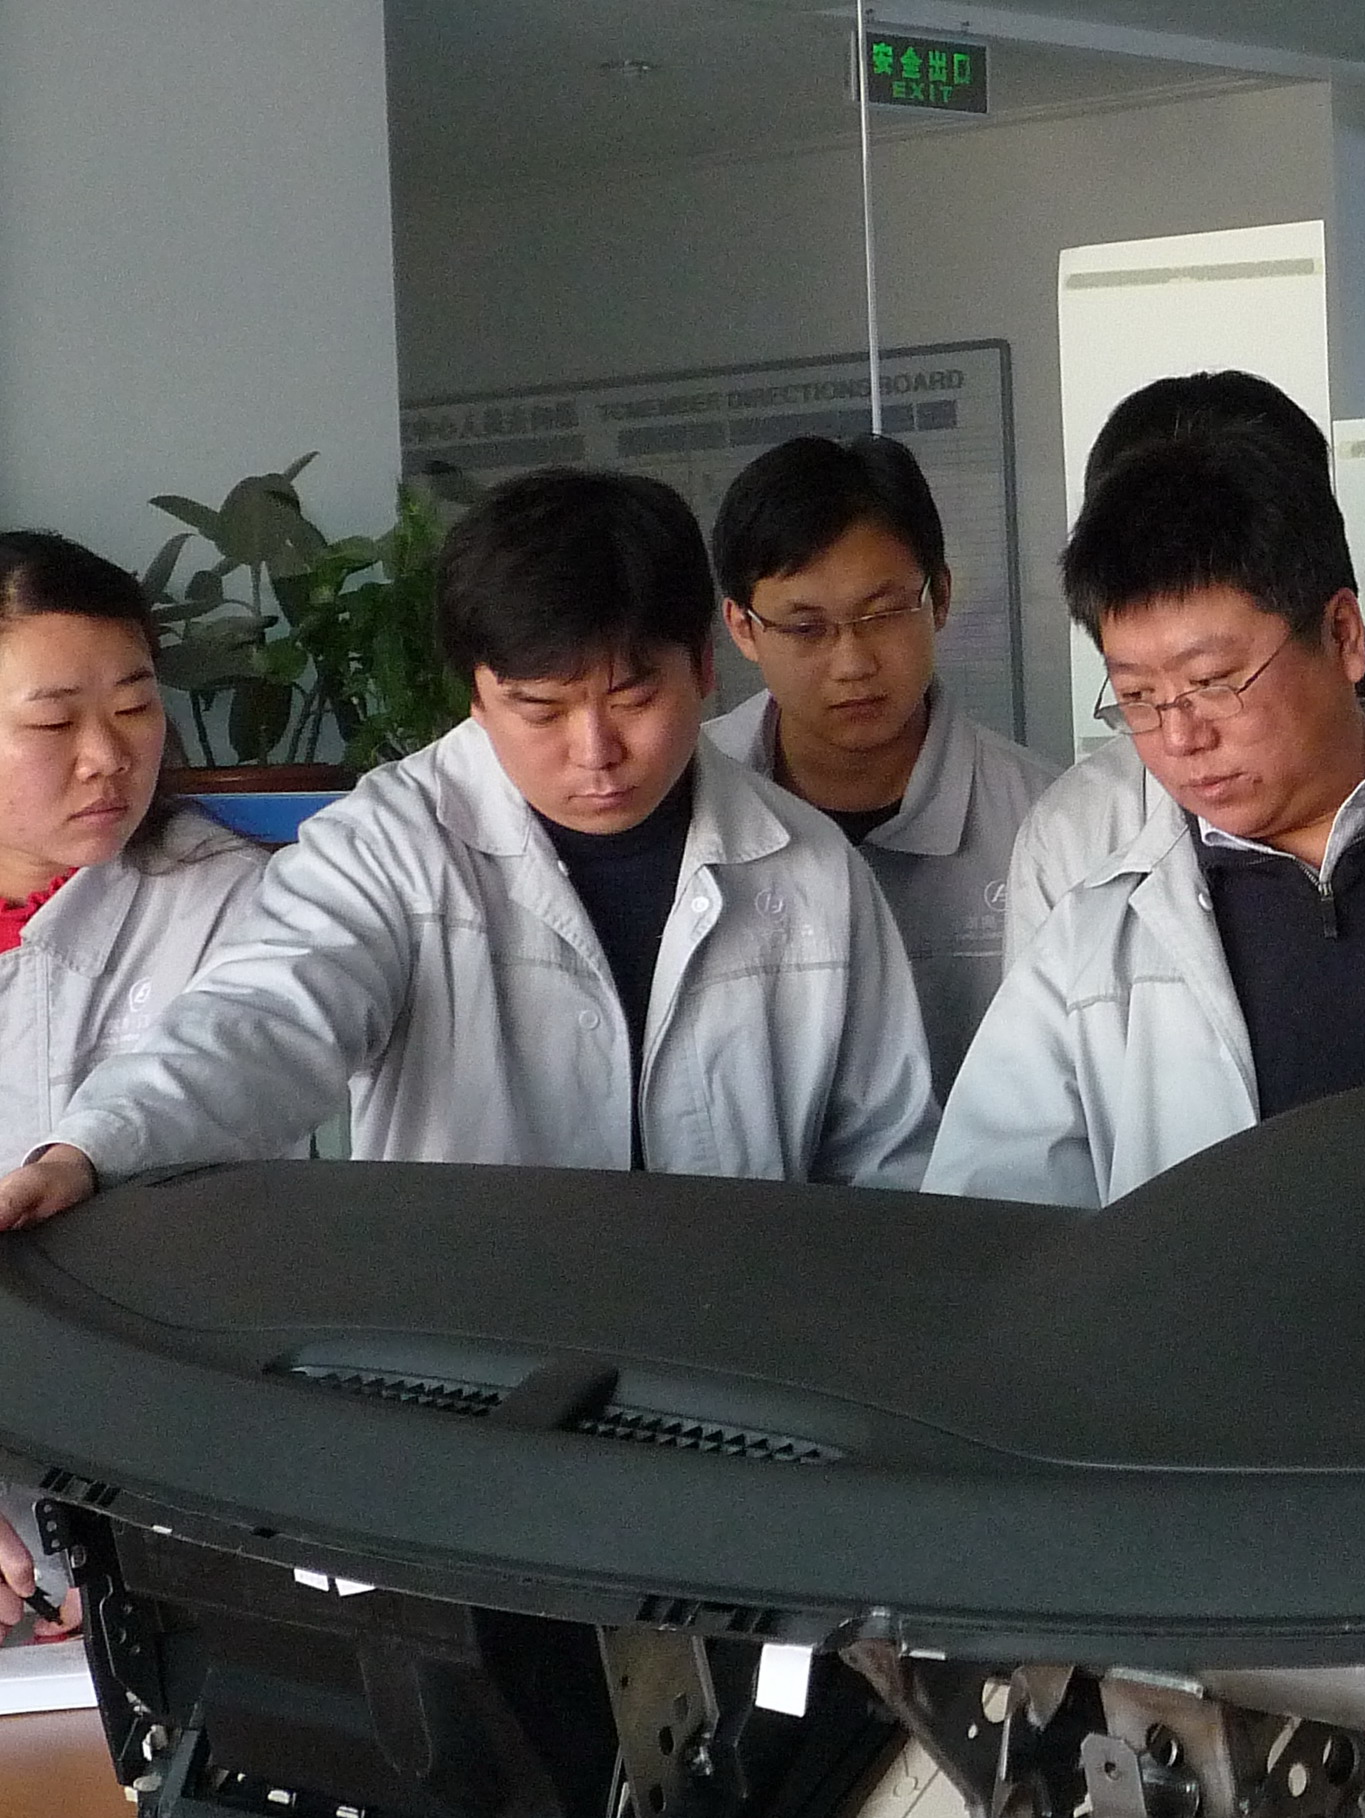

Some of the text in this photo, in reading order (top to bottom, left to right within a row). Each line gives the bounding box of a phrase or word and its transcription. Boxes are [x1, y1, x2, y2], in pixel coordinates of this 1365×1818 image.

[873, 43, 971, 84] 安全出口
[892, 81, 953, 102] EXIT
[877, 368, 965, 396] BOARD
